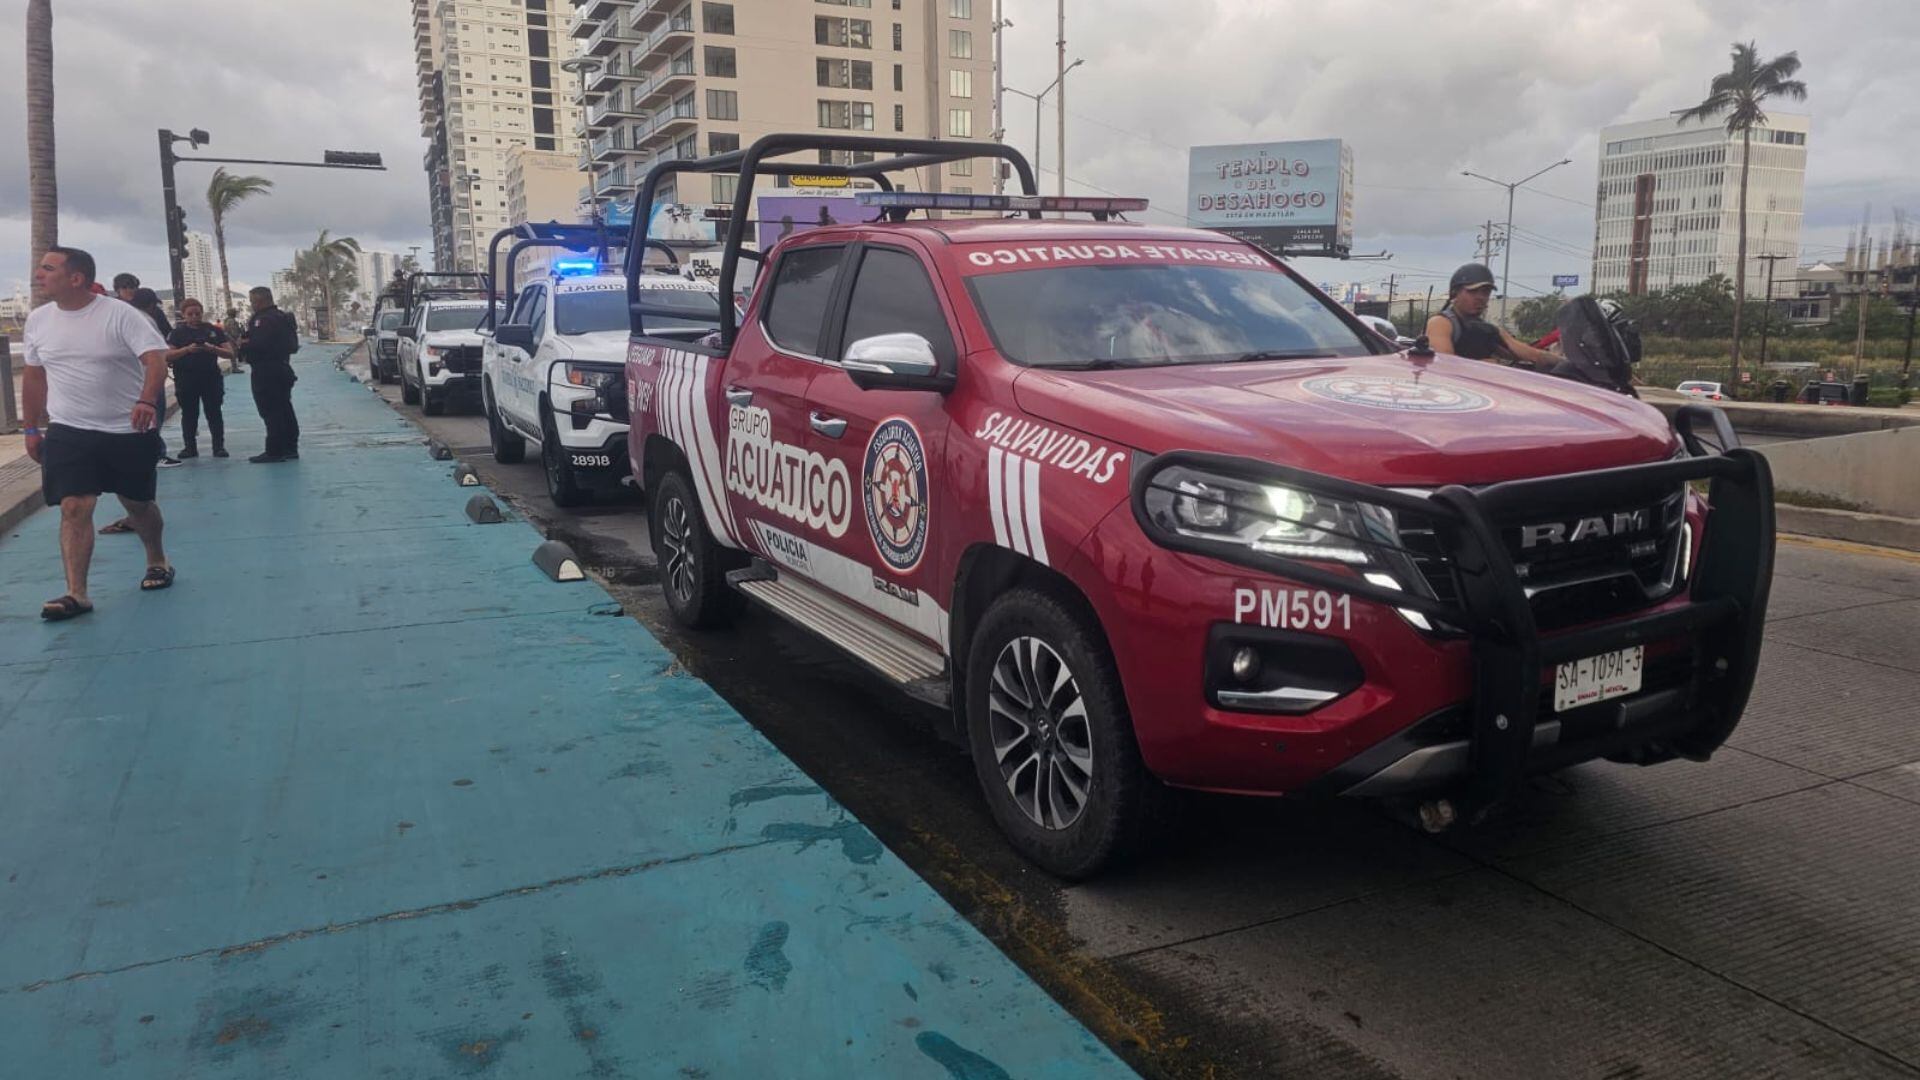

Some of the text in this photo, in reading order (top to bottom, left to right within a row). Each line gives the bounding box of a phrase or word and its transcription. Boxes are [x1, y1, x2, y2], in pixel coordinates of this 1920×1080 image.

[1216, 158, 1310, 180] TEMPLO
[1247, 178, 1276, 191] DEL
[1198, 191, 1326, 211] DESAHOGO
[731, 407, 769, 439] GRUPO
[571, 454, 611, 467] 28918
[975, 412, 1126, 483] SALVAVIDAS
[729, 438, 848, 526] ACUATICO
[1521, 509, 1648, 549] RAM
[1234, 588, 1351, 631] PM591
